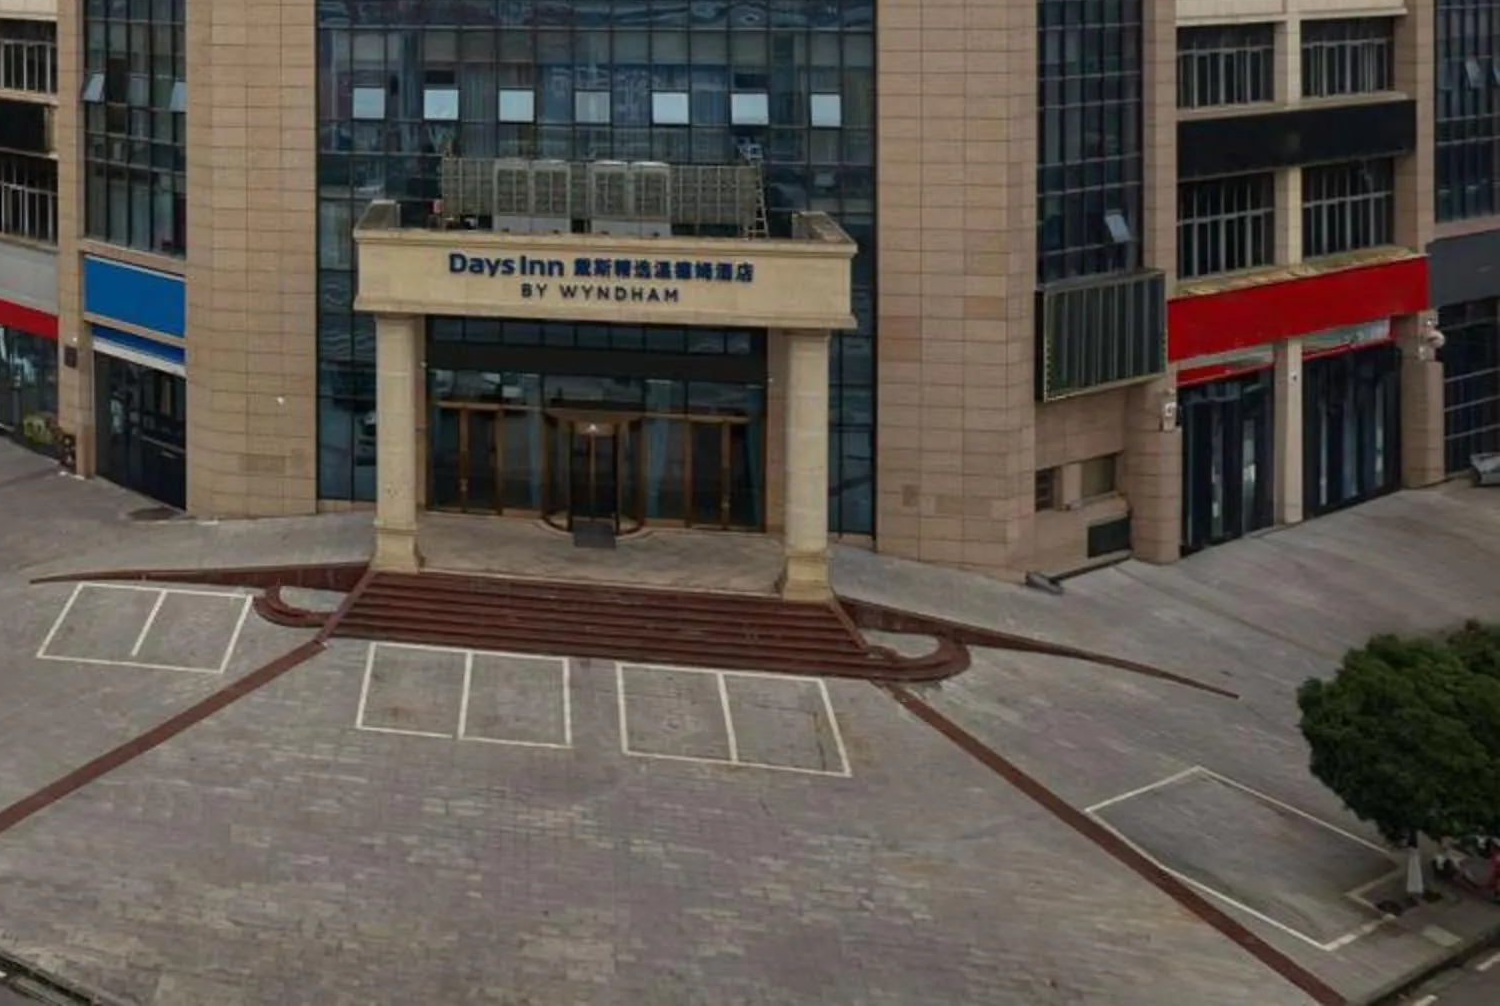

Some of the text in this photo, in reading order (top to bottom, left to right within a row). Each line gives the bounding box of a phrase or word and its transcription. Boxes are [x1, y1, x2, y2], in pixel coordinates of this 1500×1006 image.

[449, 253, 516, 278] Days
[521, 255, 565, 277] Inn
[521, 283, 679, 302] BY WYNDHAM
